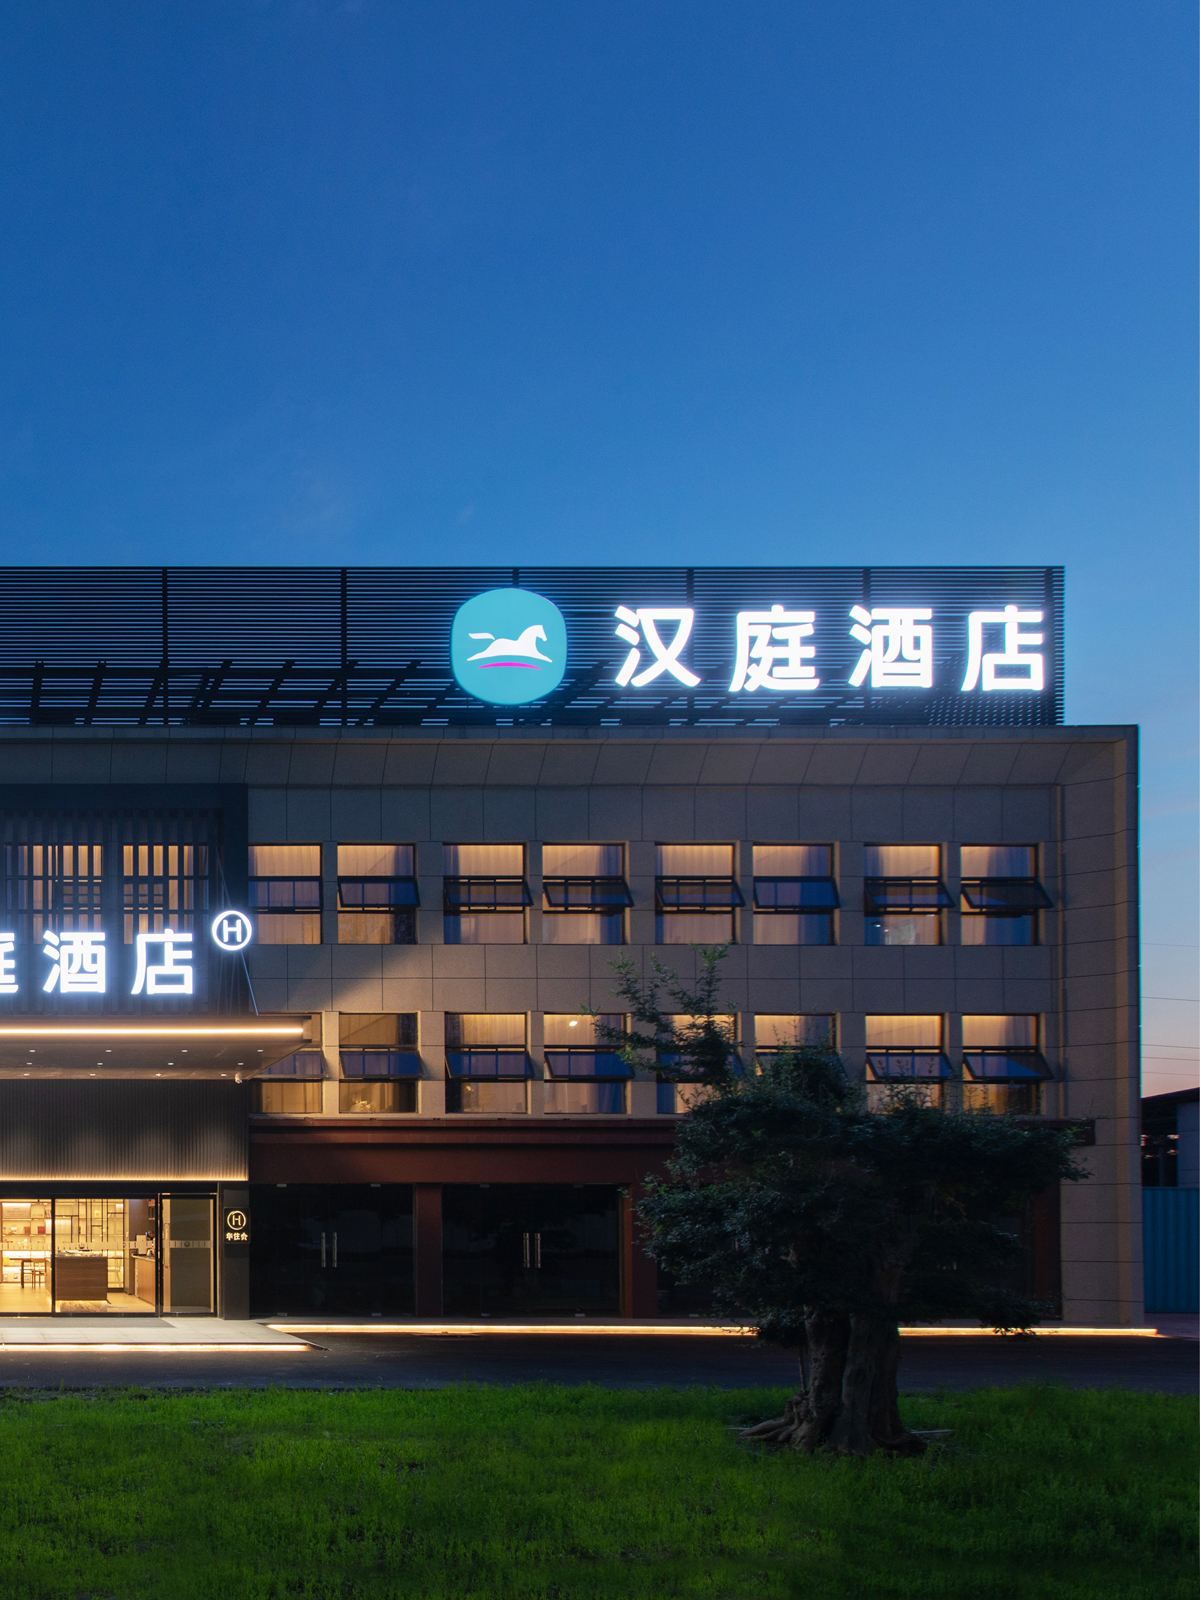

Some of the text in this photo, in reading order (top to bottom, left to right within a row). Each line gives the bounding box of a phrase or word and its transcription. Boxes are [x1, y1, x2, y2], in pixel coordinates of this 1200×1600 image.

[615, 604, 1045, 692] 汉庭酒店
[226, 1232, 248, 1241] 华住会
